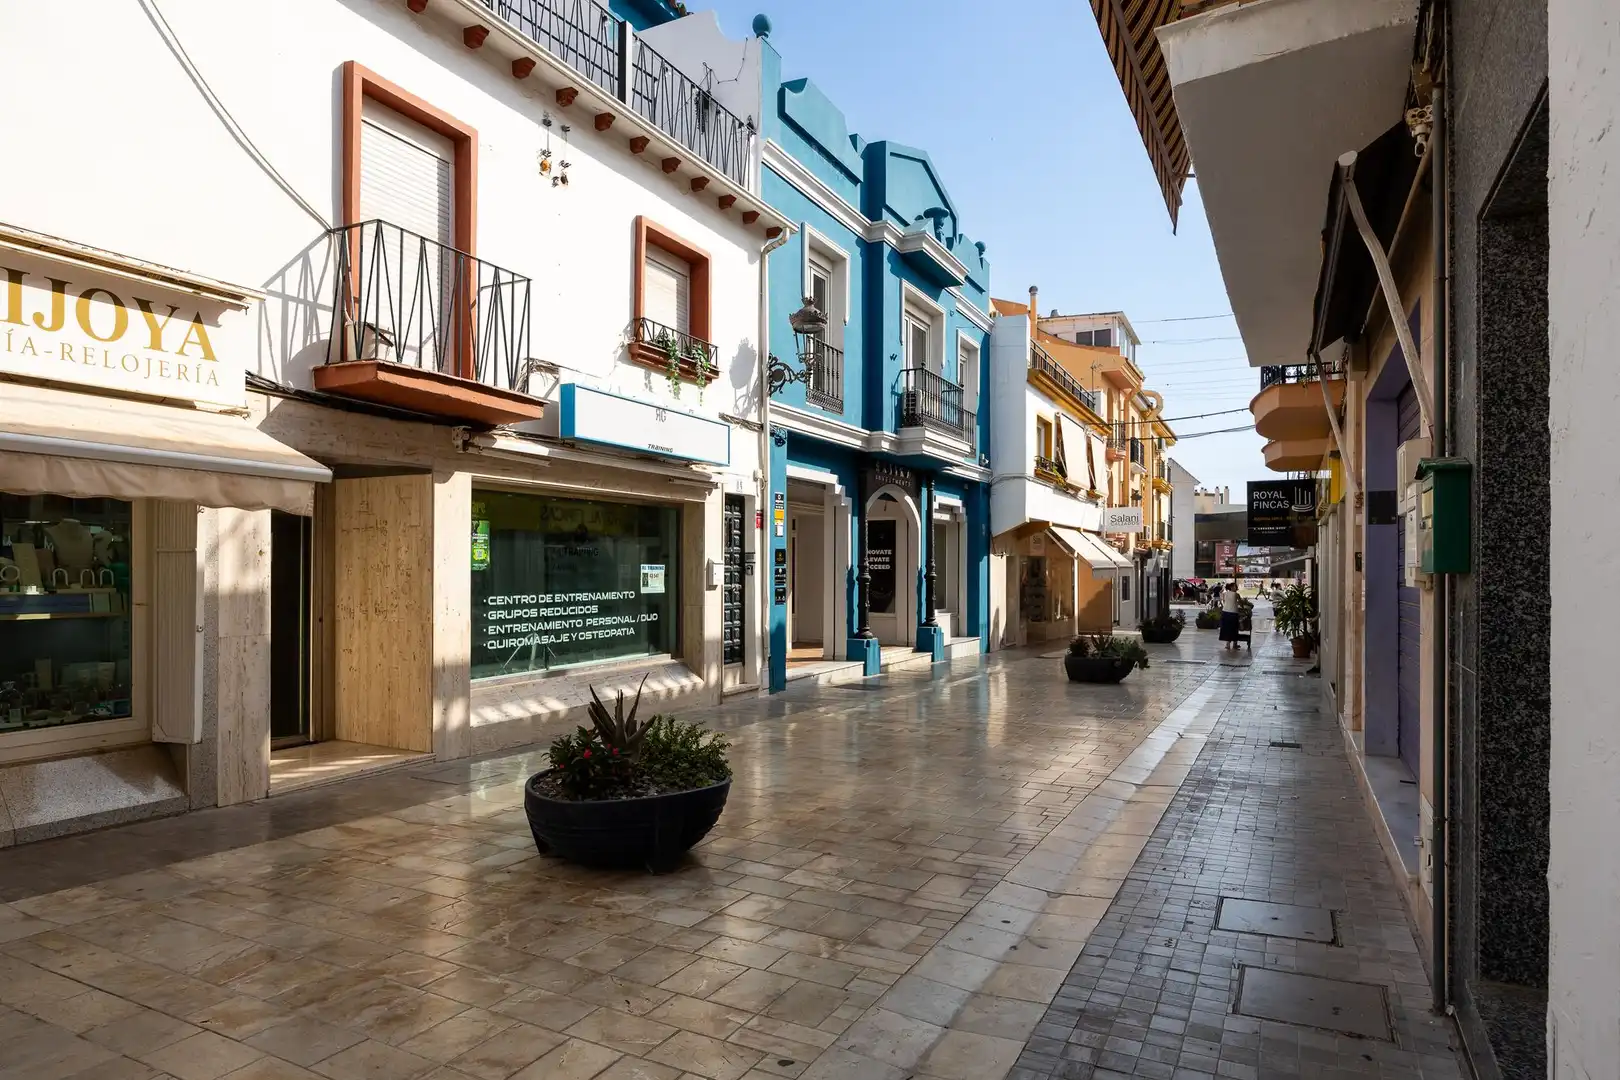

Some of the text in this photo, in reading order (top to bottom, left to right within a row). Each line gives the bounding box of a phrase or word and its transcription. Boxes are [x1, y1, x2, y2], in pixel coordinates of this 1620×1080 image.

[647, 443, 674, 453] TRAINING
[1253, 490, 1287, 500] ROYAL
[1253, 500, 1290, 510] FINCAS
[1110, 513, 1139, 523] Salani
[487, 590, 636, 606] CENTRO DE ENTRENAMIENTO
[487, 605, 599, 620] GRUPOS REDUCIDOS
[487, 619, 583, 636] ENTRENAMIENTO
[585, 615, 636, 628] PERSONAL
[487, 627, 636, 650] QUIROMASAJE Y OSTEOPATIA
